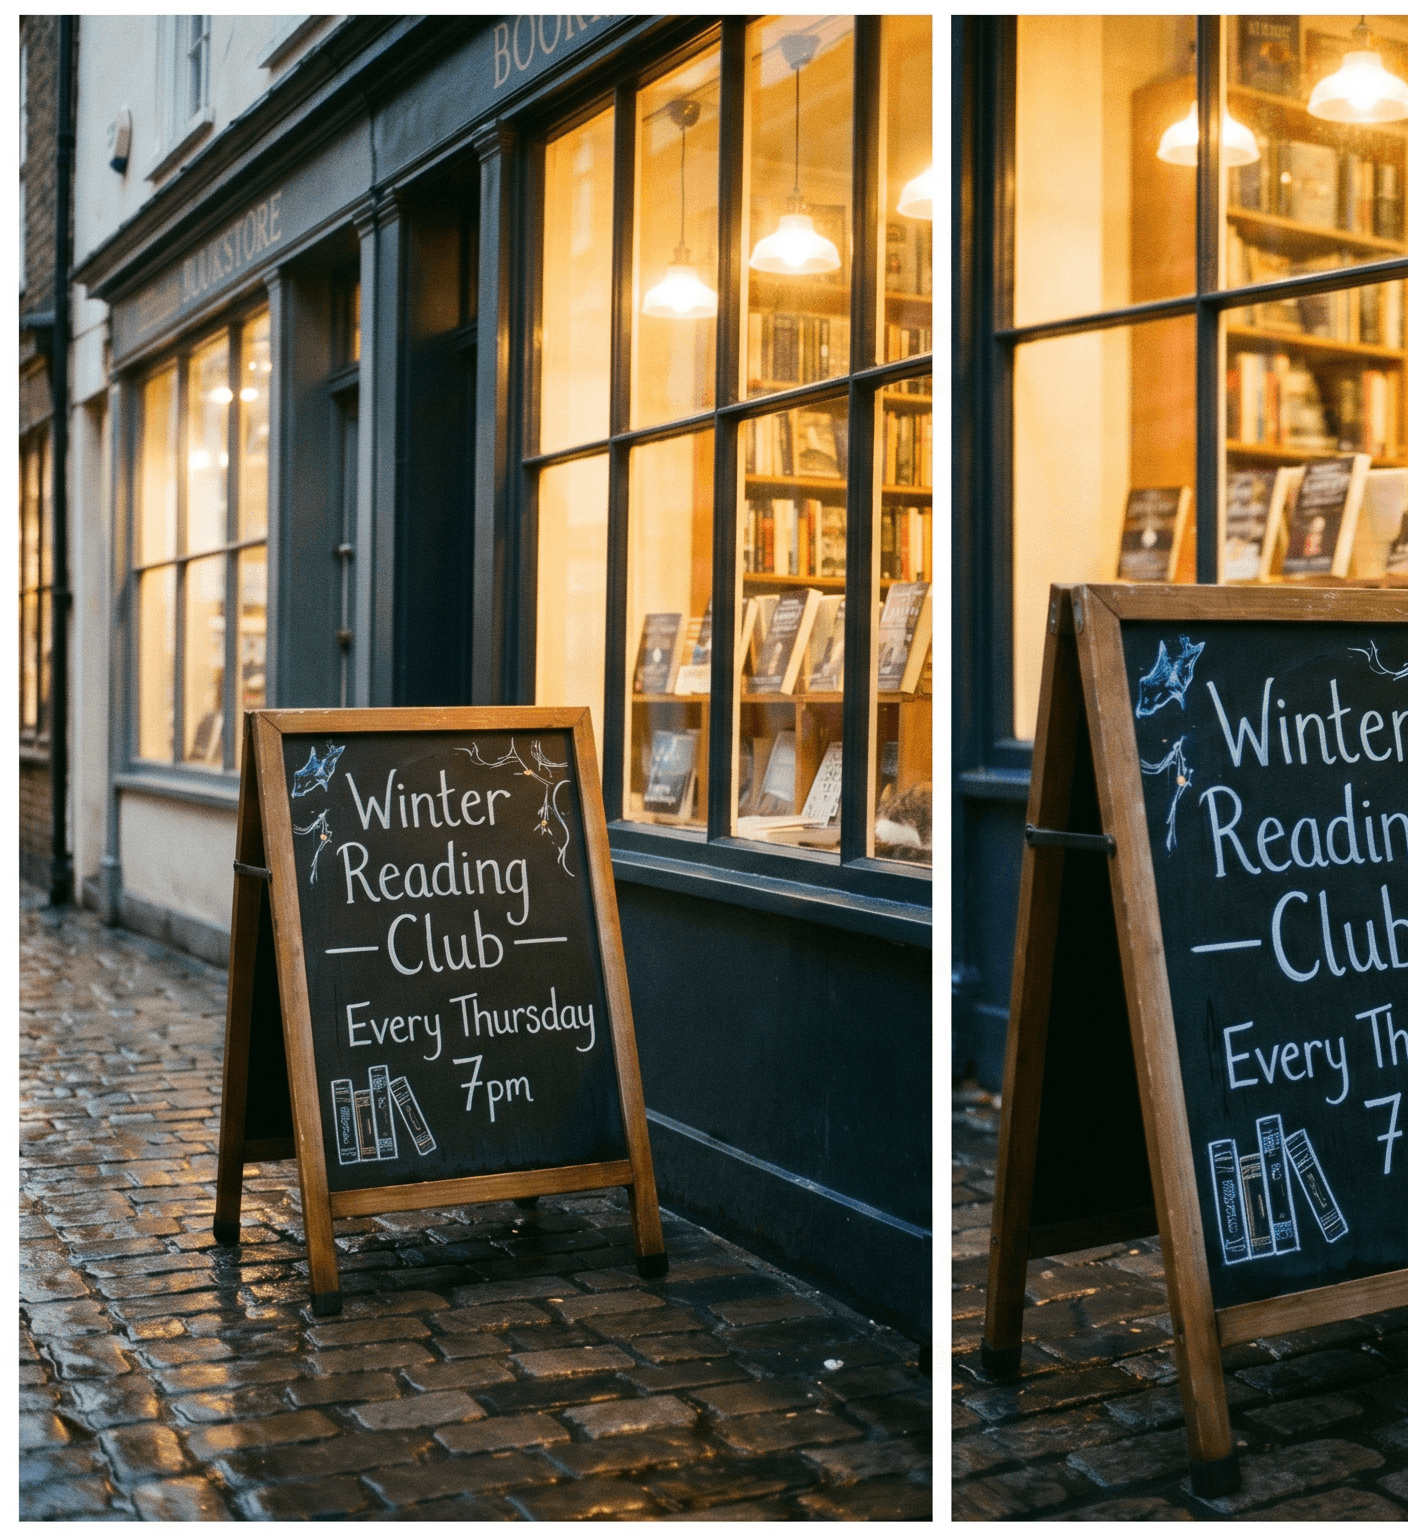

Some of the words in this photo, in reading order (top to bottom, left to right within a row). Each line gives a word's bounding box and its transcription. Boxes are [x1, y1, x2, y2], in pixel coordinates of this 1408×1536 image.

[345, 769, 511, 830] Winter
[336, 840, 530, 926] Reading
[387, 909, 504, 975] Club
[346, 1001, 442, 1061] Every
[449, 986, 596, 1052] Thursday
[452, 1055, 534, 1122] 7pm
[1223, 1021, 1350, 1105] Every
